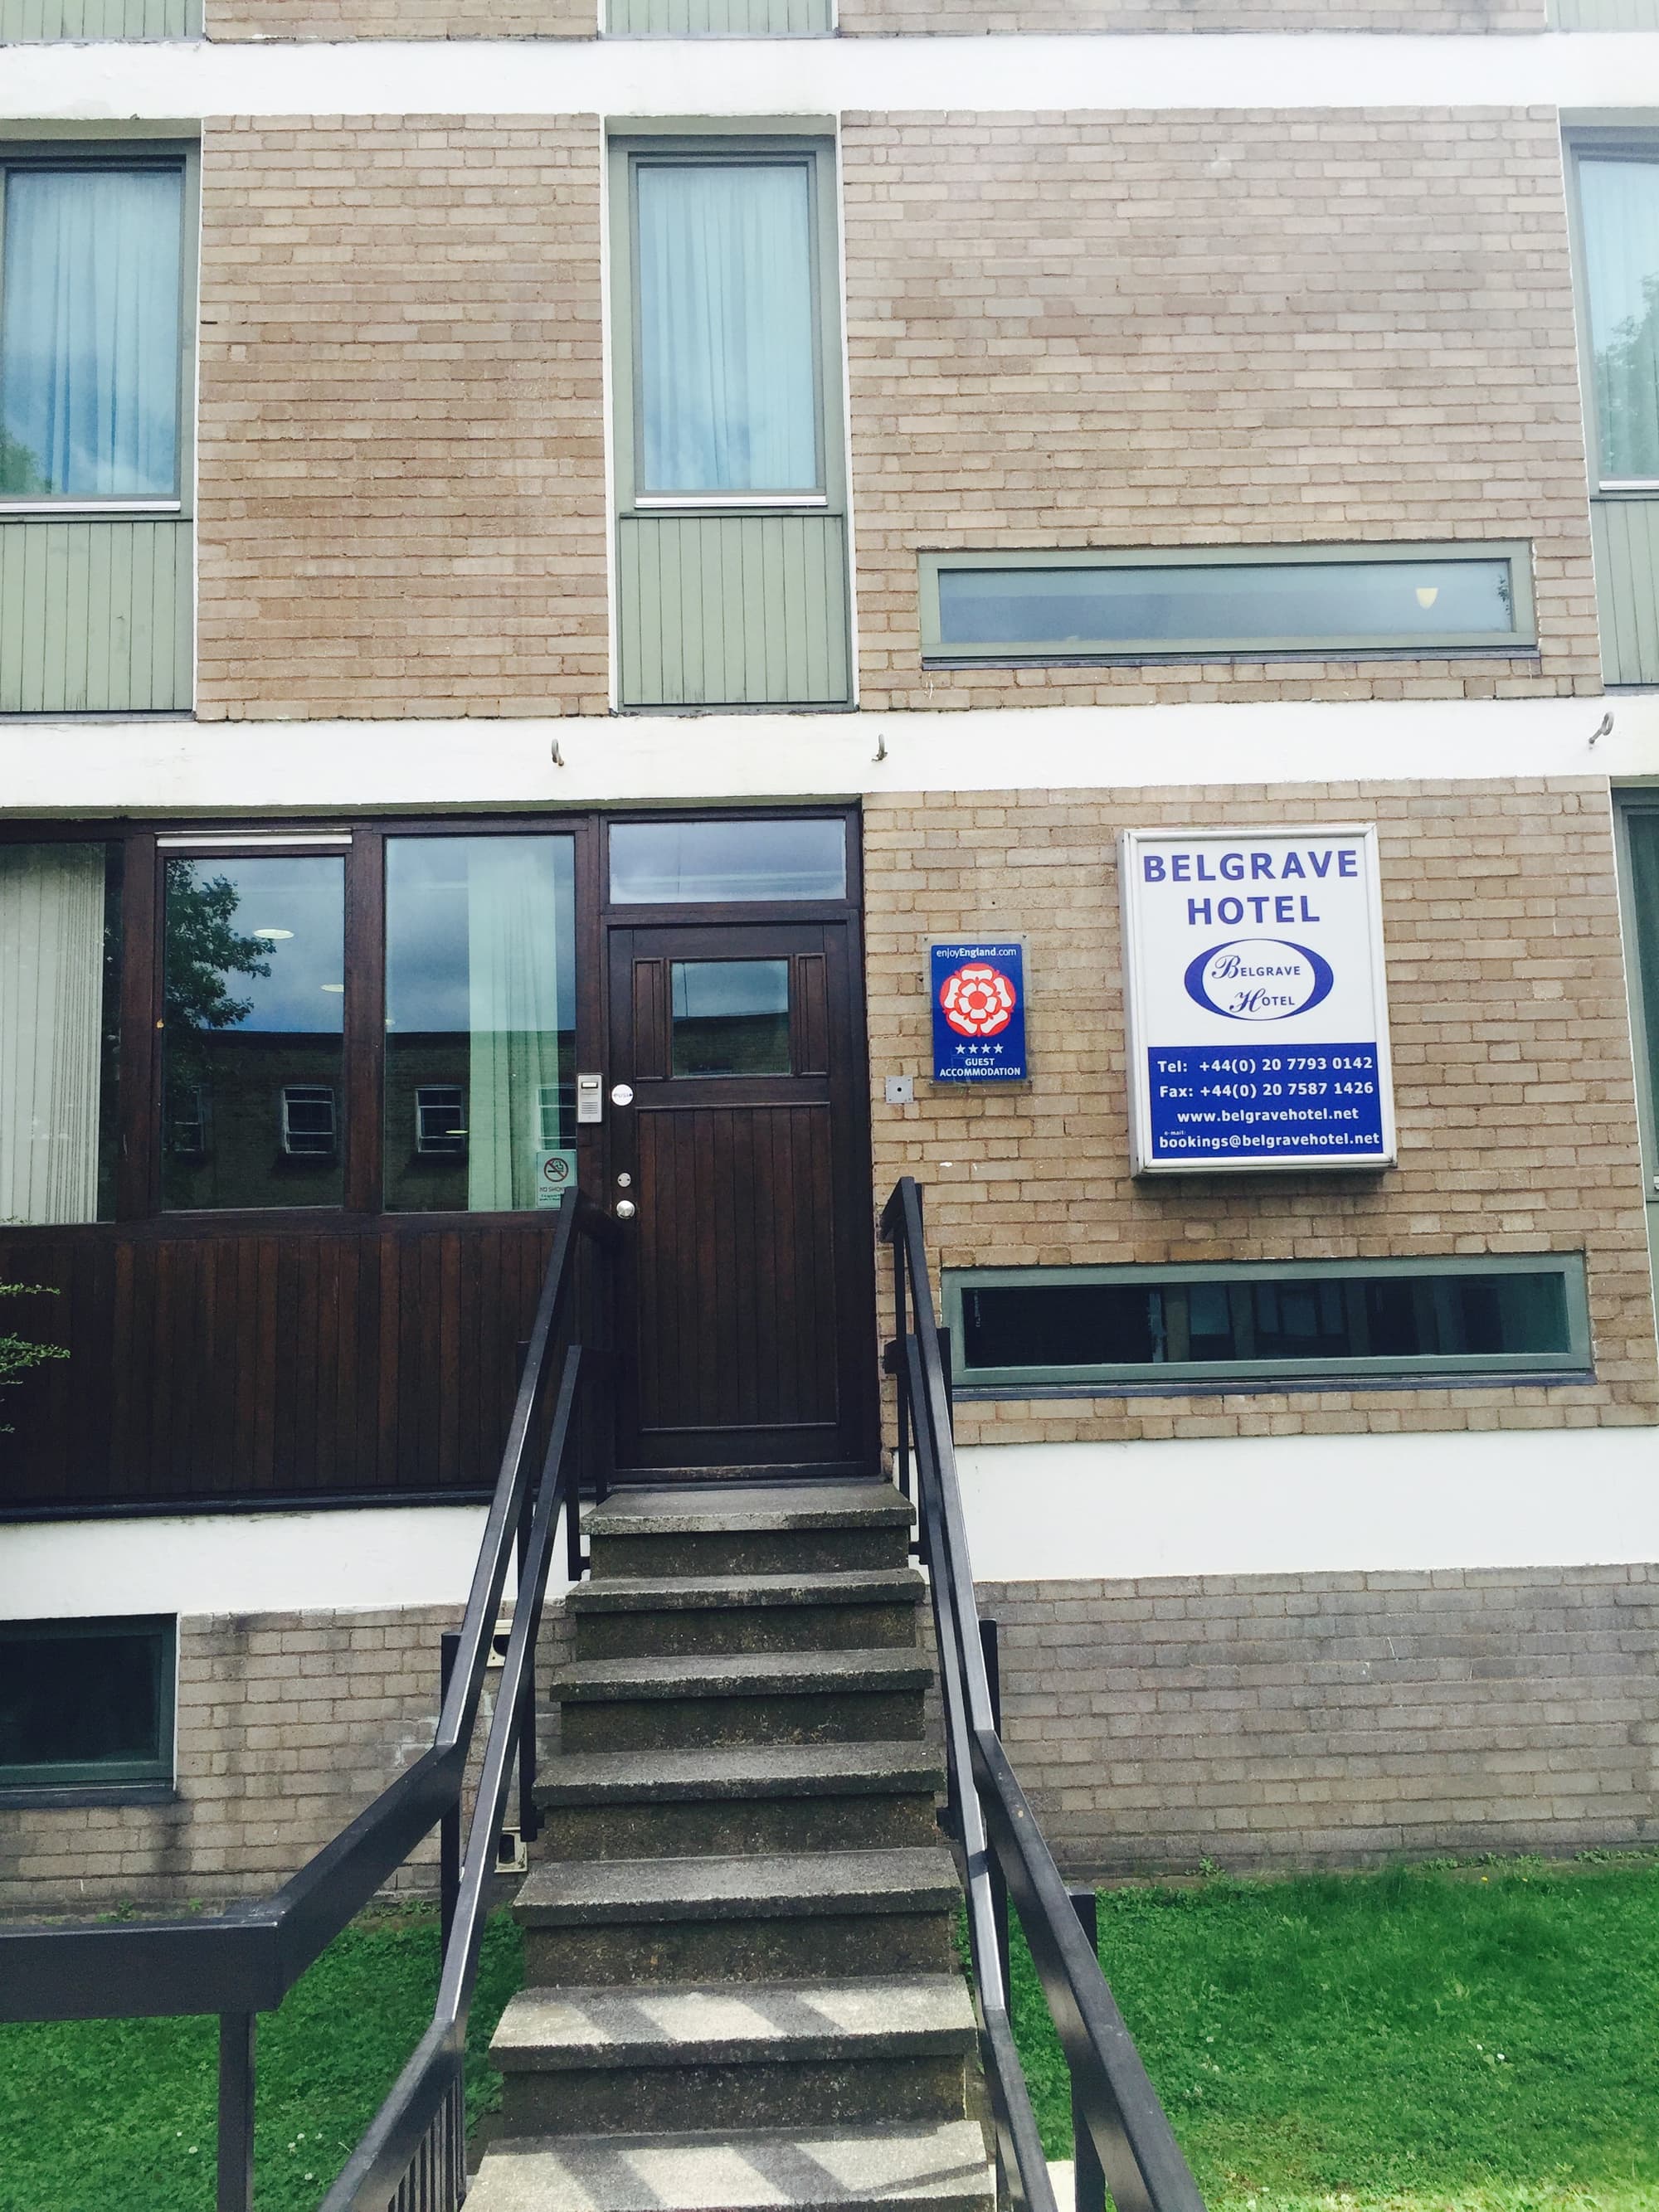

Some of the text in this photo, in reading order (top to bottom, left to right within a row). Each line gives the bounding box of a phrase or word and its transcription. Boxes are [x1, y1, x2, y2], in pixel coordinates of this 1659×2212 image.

[1143, 850, 1358, 882] BELGRAVE
[1187, 895, 1320, 925] HOTEL
[936, 947, 1017, 959] enjoyEngland.com
[965, 1057, 995, 1067] GUEST
[1157, 1057, 1373, 1074] Tel: +44(0) 20 7793 0142
[939, 1067, 1021, 1077] ACCOMMODATION
[1160, 1082, 1374, 1099] Fax: +44(0) 20 7587 1426
[1177, 1107, 1360, 1124] www.belgravehotel.net
[1159, 1132, 1379, 1150] bookings@belgravehotel.net
